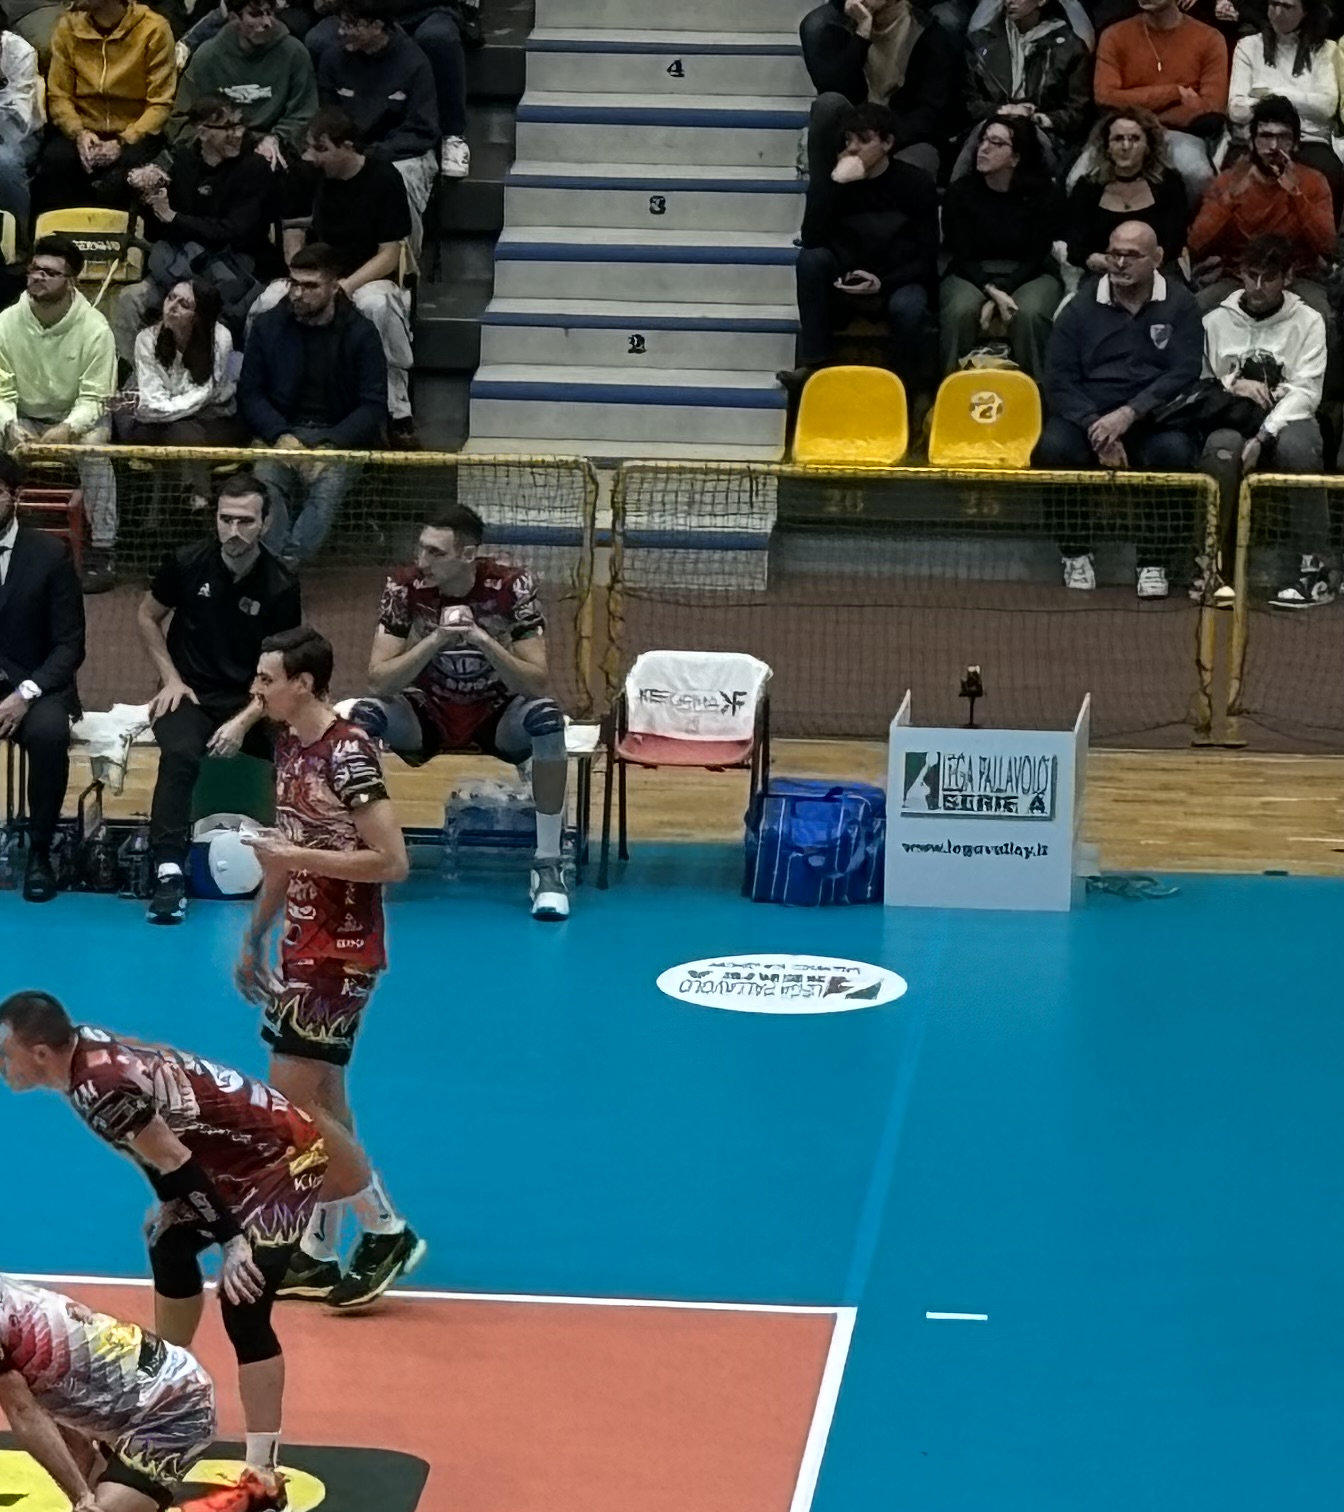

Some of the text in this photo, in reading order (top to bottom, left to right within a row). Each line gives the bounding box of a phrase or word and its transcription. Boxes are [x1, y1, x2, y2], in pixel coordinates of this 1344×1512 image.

[666, 59, 685, 78] 4
[942, 752, 1050, 795] LEGA PALLAVOLO
[1028, 793, 1048, 814] A
